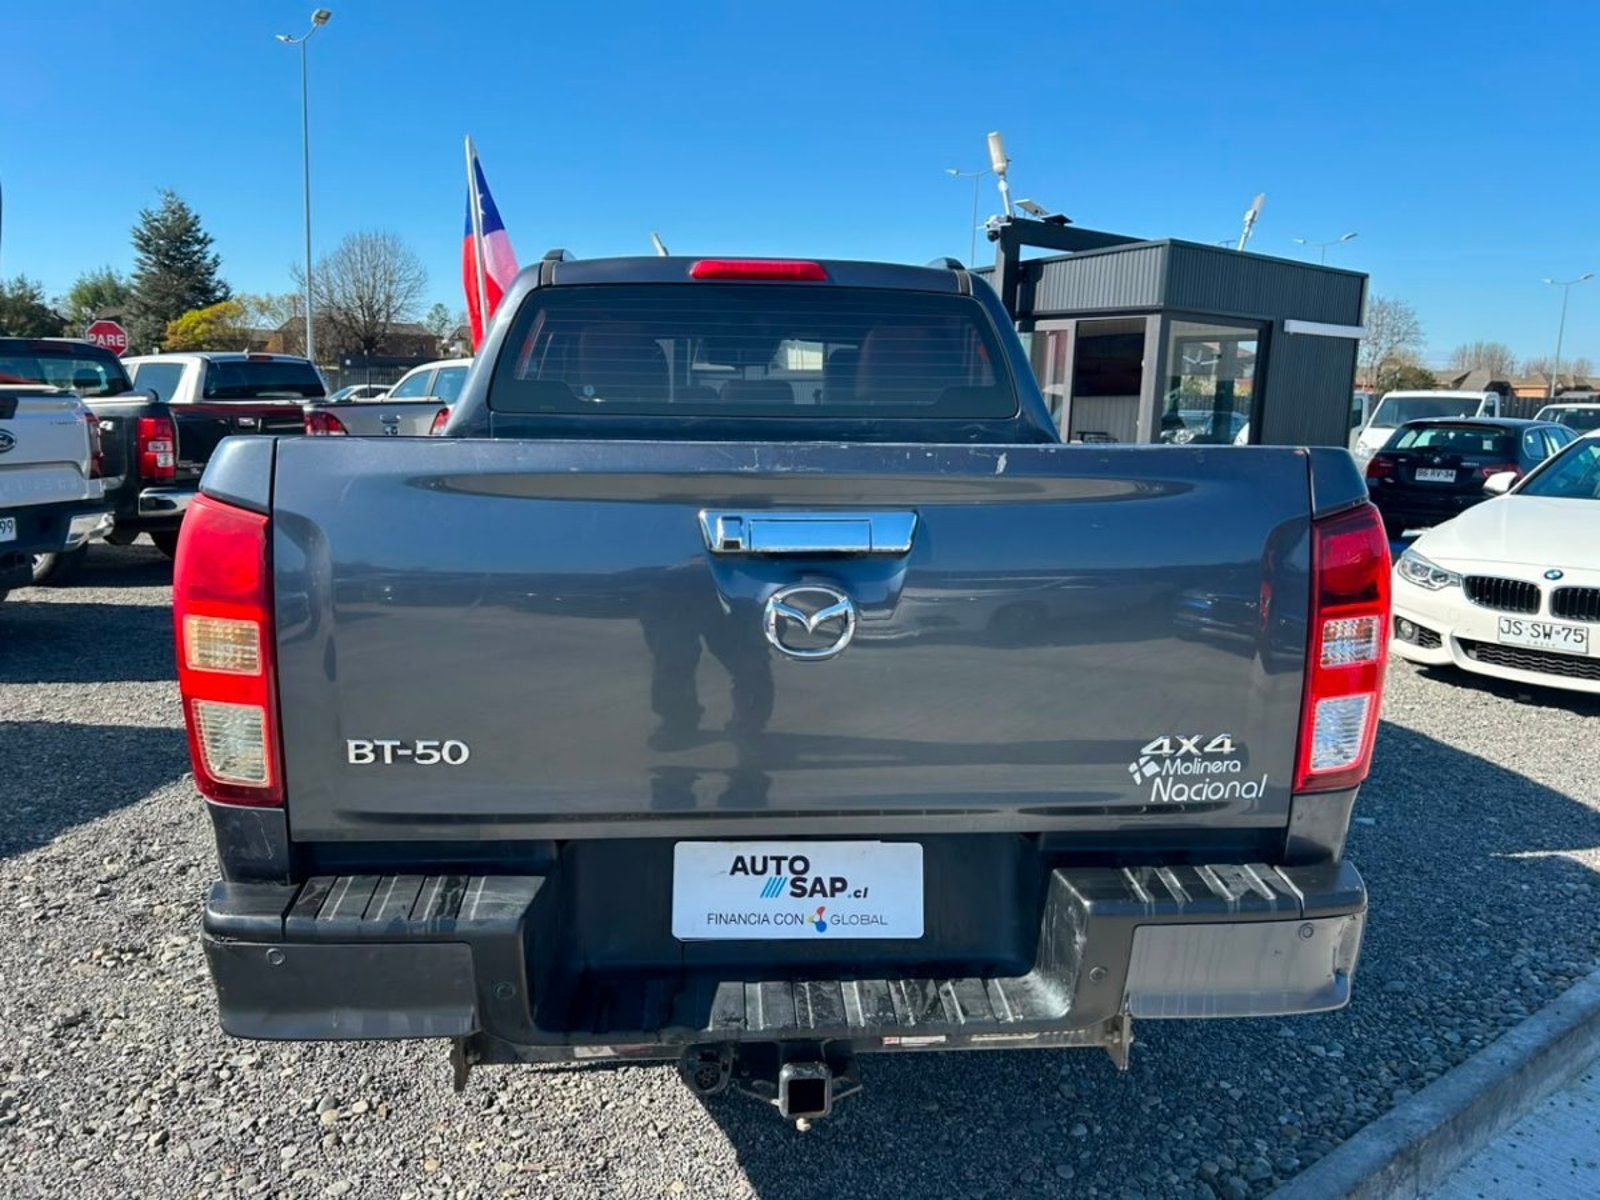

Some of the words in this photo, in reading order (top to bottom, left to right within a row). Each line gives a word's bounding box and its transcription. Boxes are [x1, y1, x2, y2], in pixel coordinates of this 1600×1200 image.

[89, 333, 125, 347] PARE
[346, 739, 470, 765] BT-50
[1161, 757, 1241, 776] Molinera
[1151, 773, 1268, 802] Nacional
[729, 855, 810, 876] AUTO
[707, 913, 770, 926] FINANCIA
[774, 913, 804, 926] CON
[830, 914, 888, 926] GLOBAL
